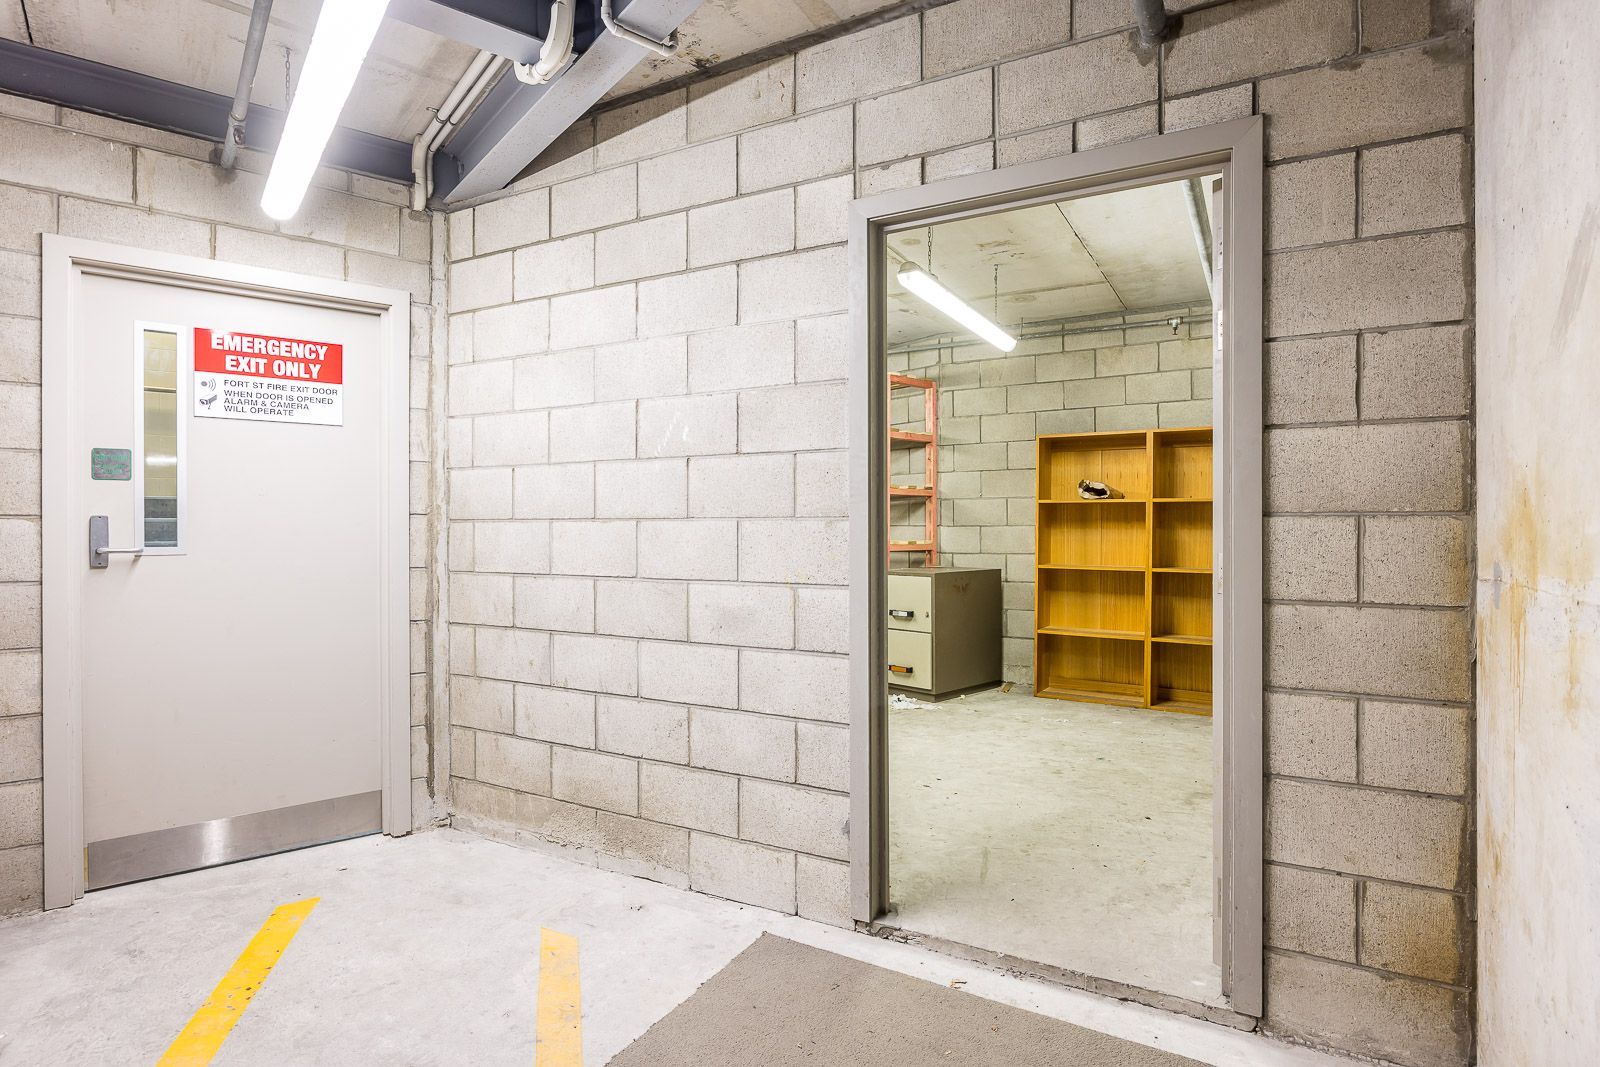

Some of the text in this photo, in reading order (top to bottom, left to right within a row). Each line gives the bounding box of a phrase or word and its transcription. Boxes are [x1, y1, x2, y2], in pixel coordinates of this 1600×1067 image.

[211, 332, 328, 360] EMERGENCY
[225, 355, 321, 379] EXIT ONLY
[224, 380, 250, 388] FORT
[313, 388, 338, 396] DOOR
[224, 390, 252, 398] WHEN
[296, 396, 333, 405] OPENED
[224, 398, 258, 406] ALARM
[270, 402, 309, 410] CAMERA
[250, 407, 294, 416] OPERATE
